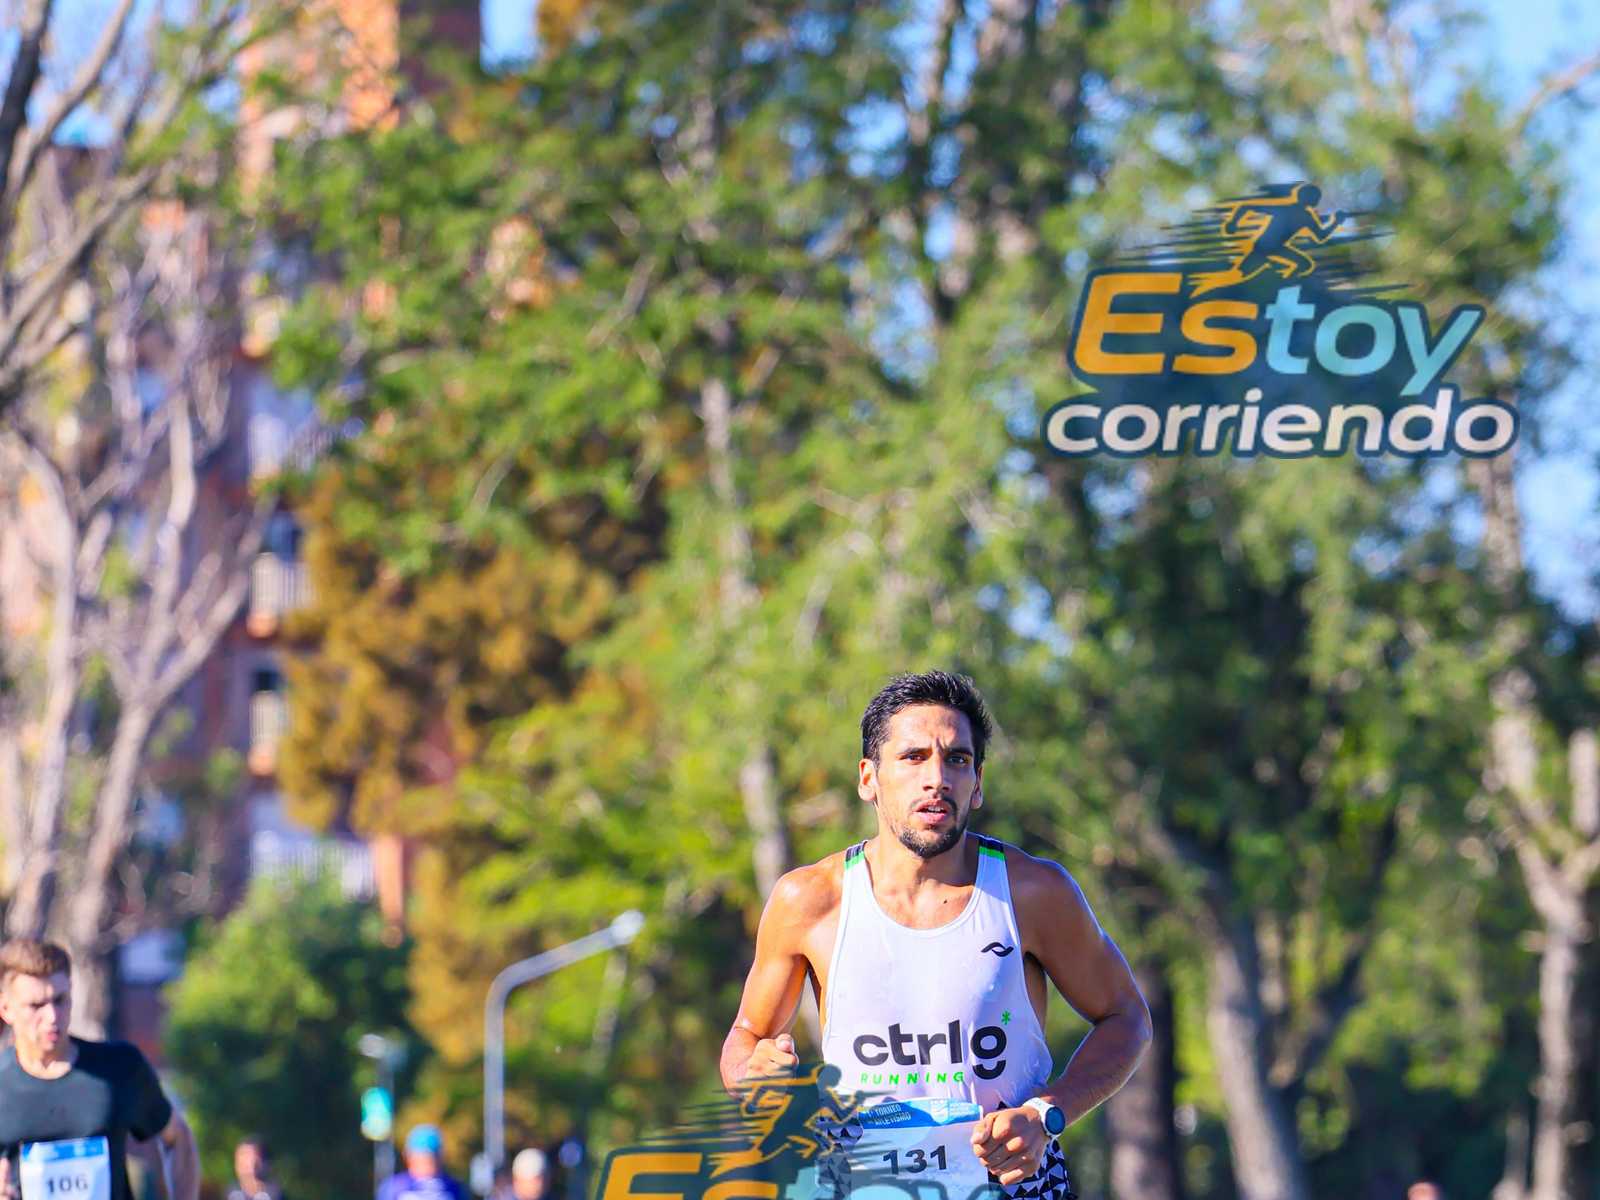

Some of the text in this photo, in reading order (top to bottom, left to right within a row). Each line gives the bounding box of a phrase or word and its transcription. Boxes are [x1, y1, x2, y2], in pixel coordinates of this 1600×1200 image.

[860, 1071, 964, 1085] RUNNING
[875, 1104, 902, 1116] TORNEO
[883, 1145, 947, 1175] 131
[46, 1173, 88, 1194] 106
